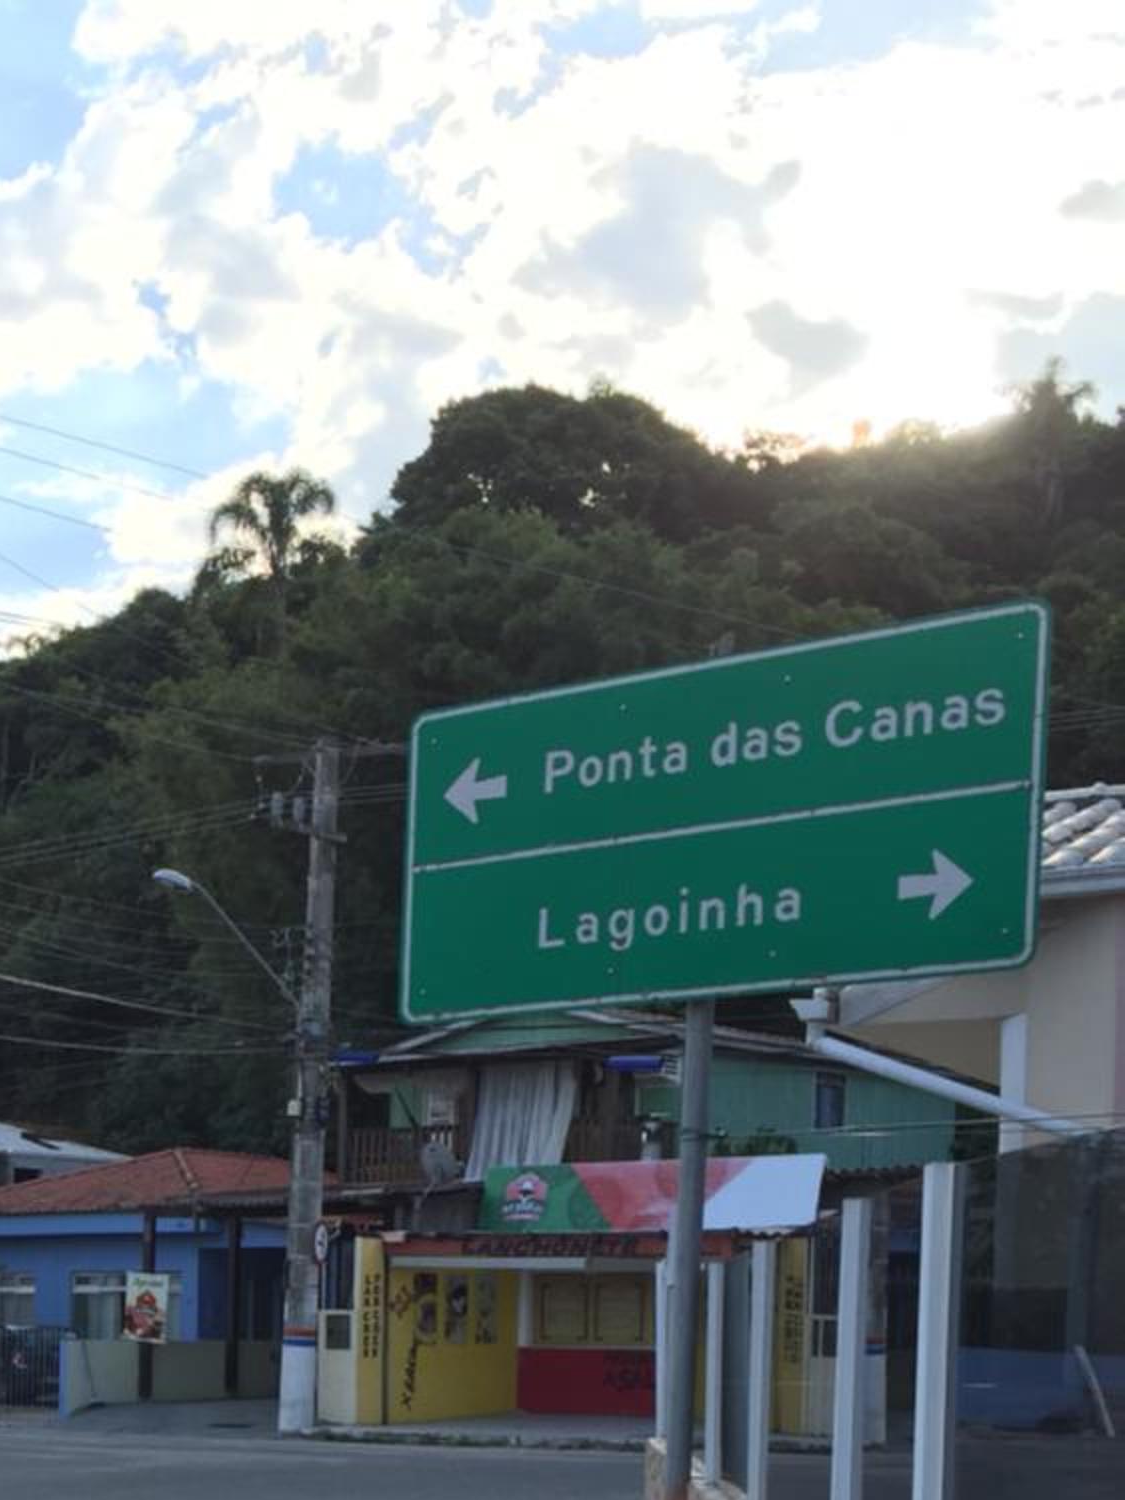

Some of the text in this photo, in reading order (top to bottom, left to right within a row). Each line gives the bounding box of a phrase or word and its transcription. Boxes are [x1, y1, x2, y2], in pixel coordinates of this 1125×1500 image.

[545, 688, 1005, 793] Ponta das Canas
[539, 884, 801, 951] Lagoinha
